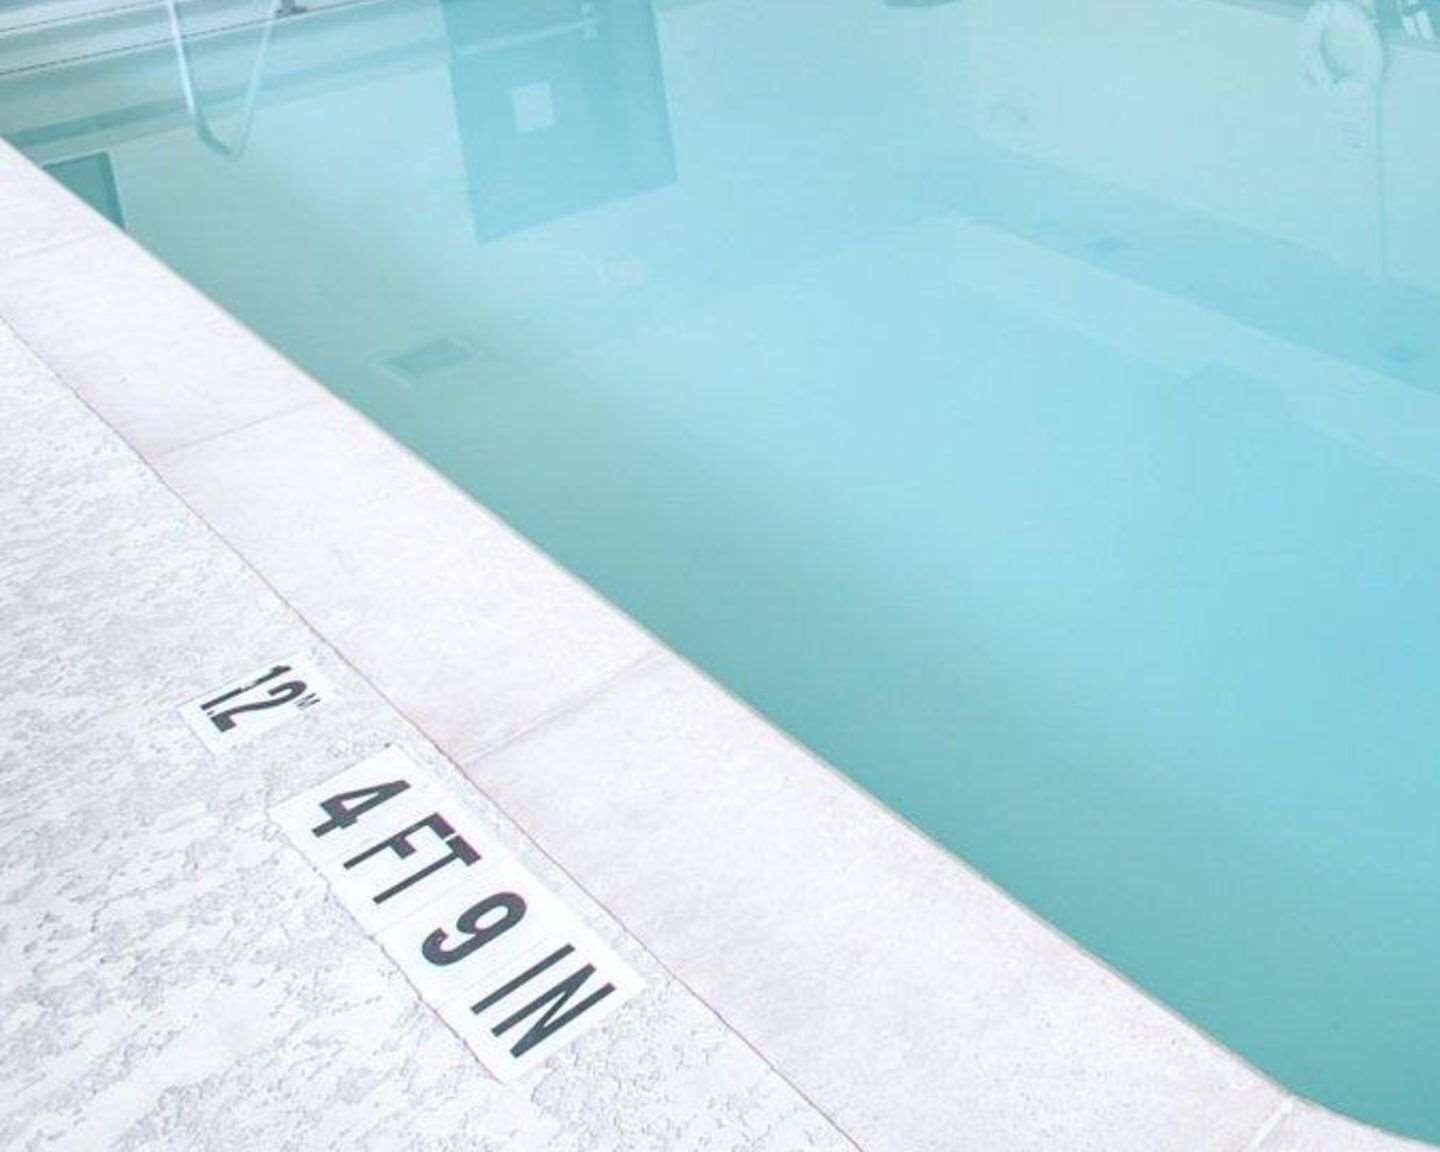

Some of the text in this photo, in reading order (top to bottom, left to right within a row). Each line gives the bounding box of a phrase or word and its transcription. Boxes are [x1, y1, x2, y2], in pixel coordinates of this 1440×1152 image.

[311, 779, 616, 1059] 4 FT 9 IN
